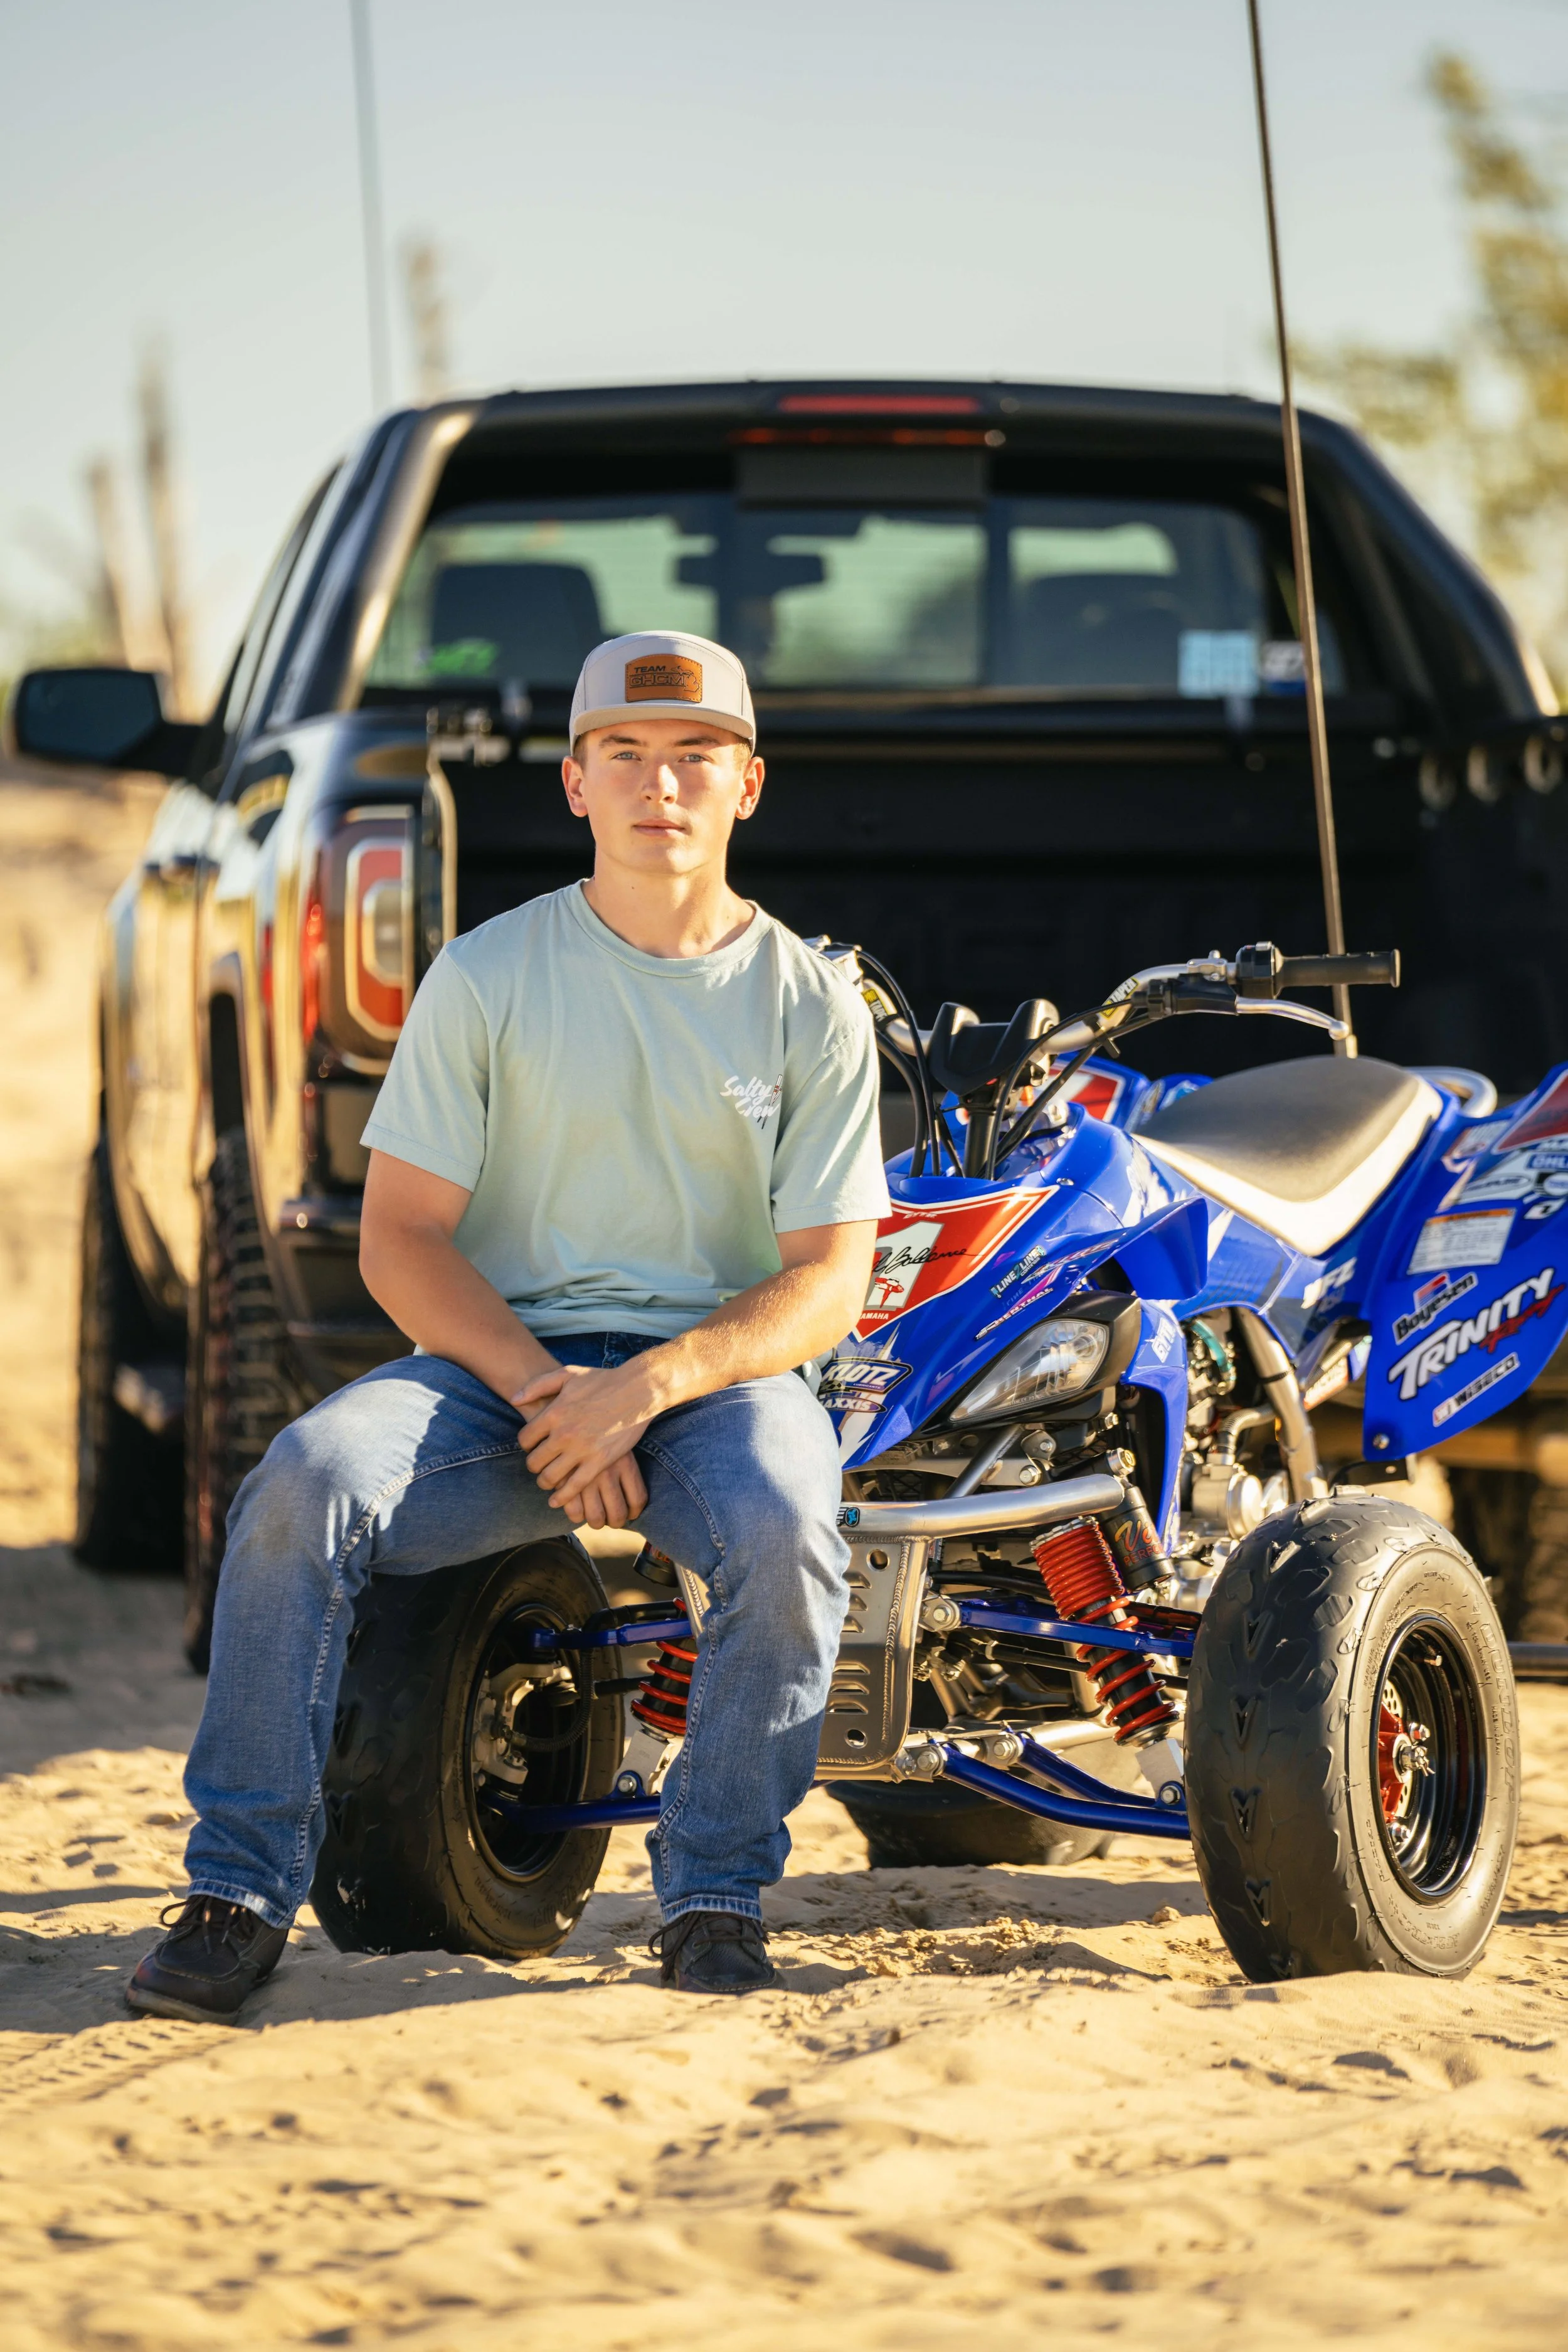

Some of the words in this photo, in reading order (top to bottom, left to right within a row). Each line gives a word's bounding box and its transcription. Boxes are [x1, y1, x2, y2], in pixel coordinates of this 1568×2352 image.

[719, 1075, 773, 1106] Salty
[735, 1098, 780, 1118] Crew
[860, 1312, 889, 1320] AMAHA
[1387, 1267, 1555, 1401] TRINITY
[822, 1364, 901, 1386] KLOTZ
[1480, 1622, 1518, 1804] DUNLOP
